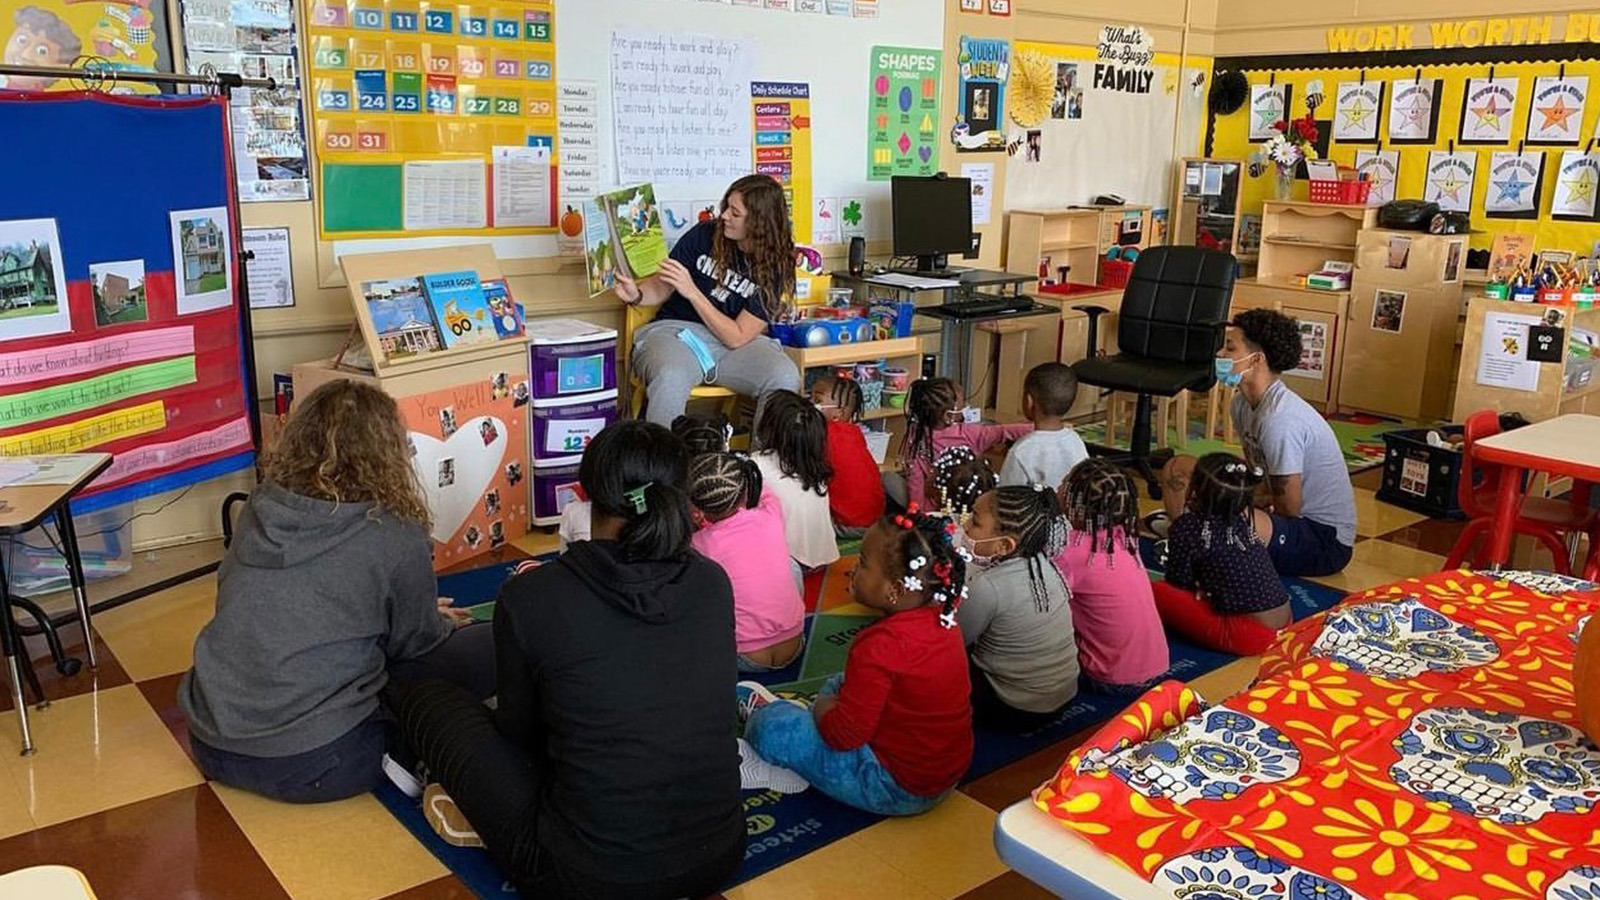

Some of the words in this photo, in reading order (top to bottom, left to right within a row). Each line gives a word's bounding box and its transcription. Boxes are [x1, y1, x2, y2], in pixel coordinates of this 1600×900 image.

[325, 10, 336, 22] 9
[359, 12, 378, 24] 10
[396, 14, 412, 27] 11
[426, 16, 444, 28] 12
[464, 21, 482, 33] 13
[497, 23, 515, 36] 14
[531, 24, 546, 37] 15
[612, 32, 626, 47] Are
[629, 41, 641, 55] you
[643, 35, 666, 55] ready
[669, 36, 677, 50] to
[680, 38, 696, 51] work
[700, 40, 713, 54] and
[1105, 26, 1142, 44] What's
[1327, 25, 1414, 52] WORK
[1430, 16, 1554, 49] WORTH
[1096, 43, 1117, 60] The
[323, 51, 341, 64] 16
[360, 54, 378, 66] 17
[396, 55, 415, 68] 18
[431, 58, 449, 71] 19
[461, 60, 482, 74] 20
[498, 61, 516, 74] 21
[529, 64, 549, 77] 22
[613, 53, 620, 70] I
[622, 60, 633, 69] am
[636, 58, 658, 80] ready
[661, 58, 669, 72] to
[673, 58, 691, 74] work
[879, 53, 935, 71] SHAPES
[613, 76, 626, 92] Are
[628, 82, 639, 96] you
[640, 80, 661, 99] ready
[1094, 64, 1154, 93] FAMILY
[323, 91, 347, 105] 23
[362, 96, 385, 108] 24
[395, 97, 417, 109] 25
[429, 94, 451, 107] 26
[467, 99, 487, 111] 27
[497, 100, 518, 112] 28
[530, 101, 550, 113] 29
[564, 88, 588, 97] Monday
[563, 105, 588, 113] Tuesday
[633, 102, 655, 120] ready
[714, 104, 728, 121] day
[756, 105, 780, 114] Centers
[328, 134, 351, 147] 30
[362, 134, 381, 147] 31
[567, 154, 587, 162] Friday
[564, 170, 591, 178] Saturday
[14, 357, 27, 374] do
[29, 362, 43, 373] we
[45, 354, 67, 371] know
[21, 400, 33, 417] do
[37, 402, 49, 414] we
[51, 390, 75, 411] want
[824, 625, 865, 646] gre
